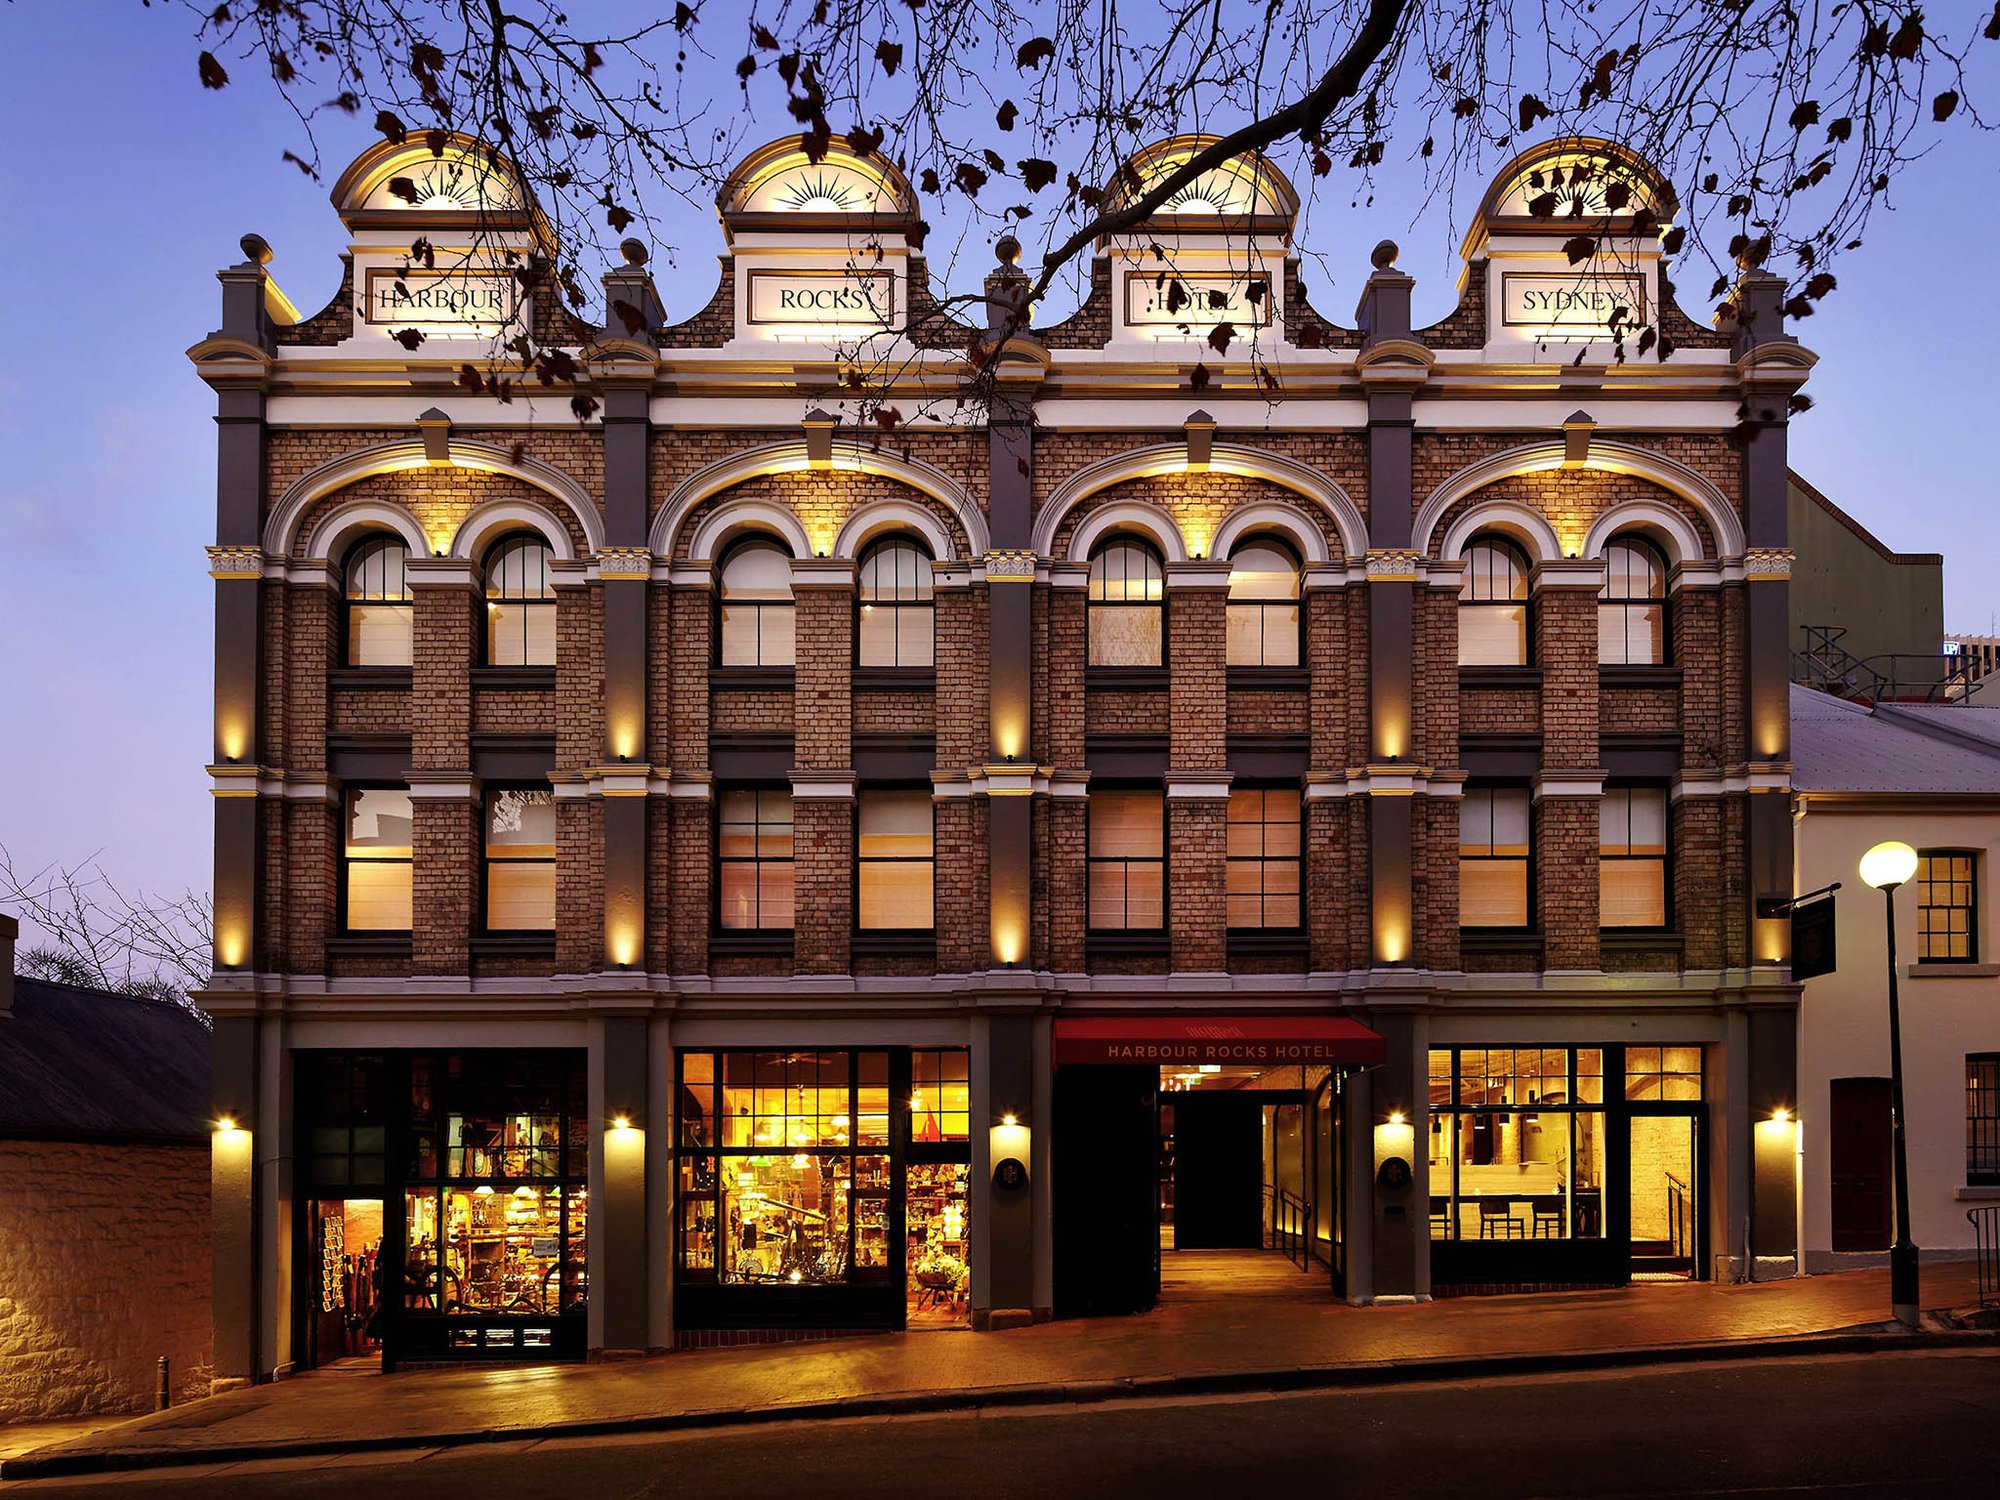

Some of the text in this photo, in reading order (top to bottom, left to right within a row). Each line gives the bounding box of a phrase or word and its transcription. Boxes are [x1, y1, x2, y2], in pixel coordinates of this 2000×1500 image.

[380, 289, 503, 308] HARBOUR
[780, 289, 863, 309] ROCKS
[1523, 291, 1623, 310] SYDNEY
[1108, 1046, 1334, 1058] HARBOUR ROCKS HOTEL
